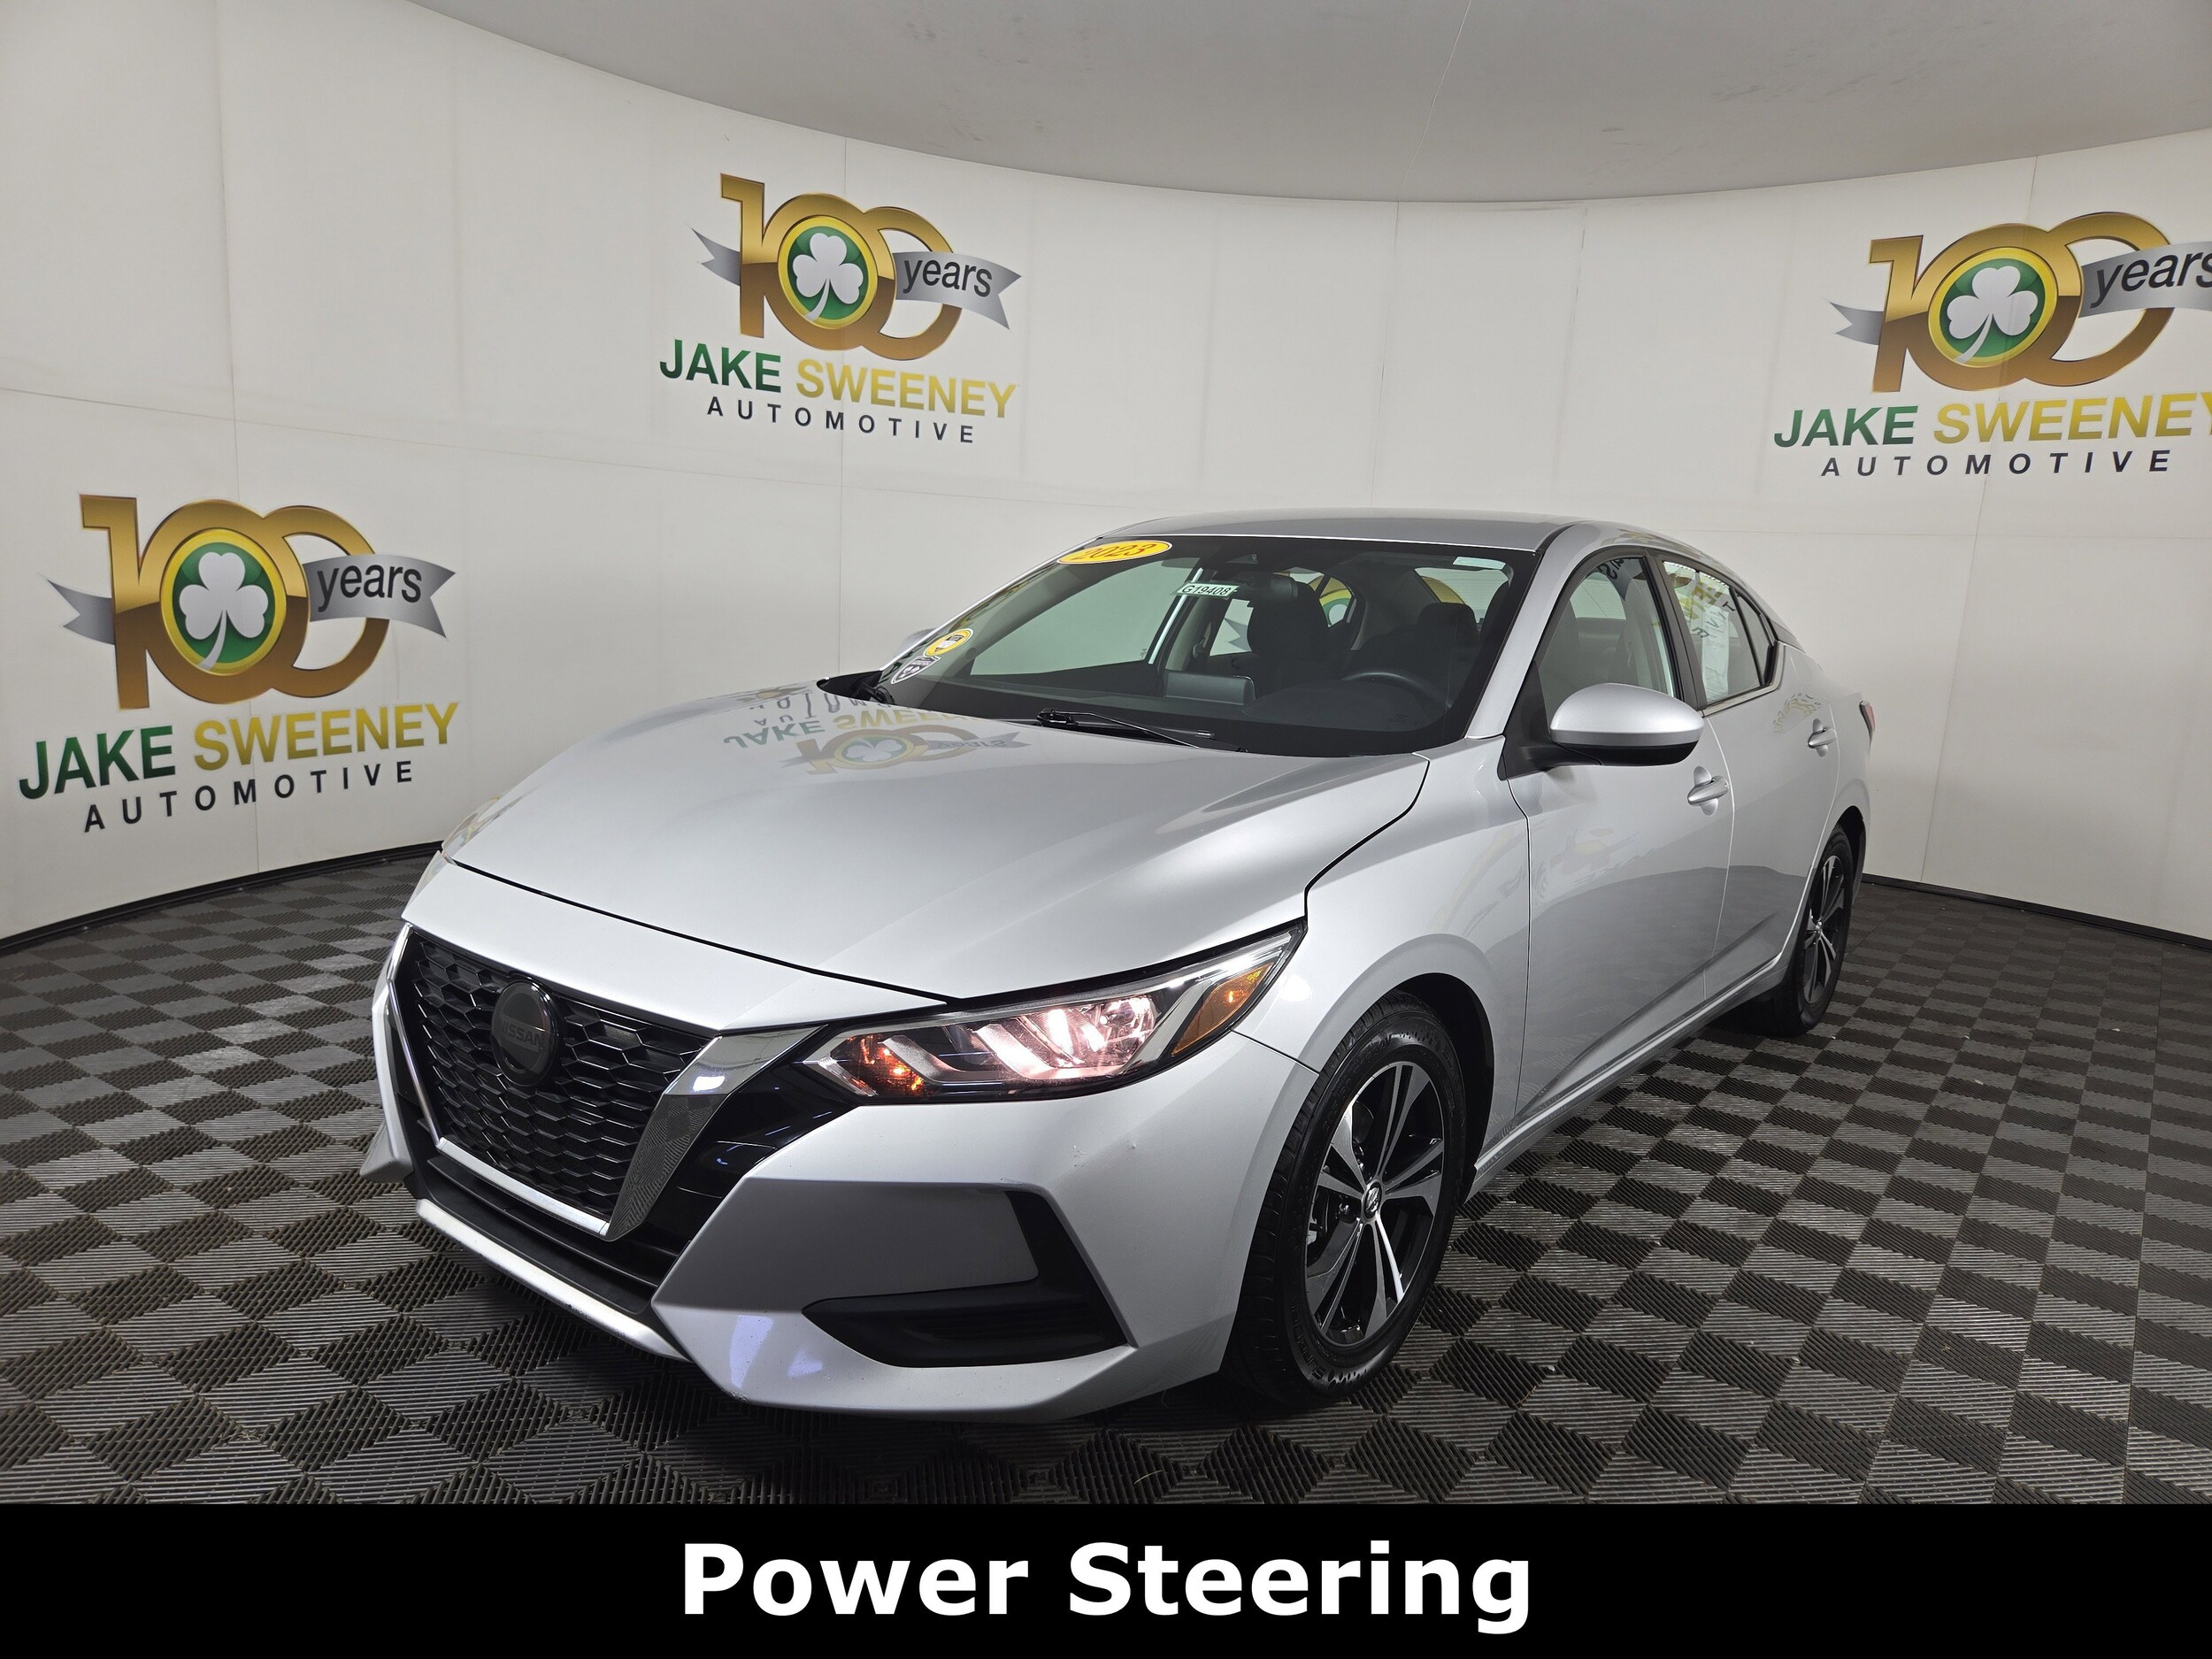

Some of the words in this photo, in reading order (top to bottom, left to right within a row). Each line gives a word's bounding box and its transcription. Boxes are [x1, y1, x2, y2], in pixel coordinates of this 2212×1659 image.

[720, 173, 963, 361] 100
[902, 257, 993, 298] years
[1869, 211, 2175, 394] 100
[2090, 250, 2212, 308] years
[659, 339, 781, 393] JAKE
[796, 358, 1018, 419] SWEENEY
[707, 396, 973, 443] AUTOMOTIVE
[1774, 405, 1919, 448] JAKE
[1821, 449, 2171, 477] AUTOMOTIVE
[1071, 543, 1157, 560] 2023
[80, 494, 390, 710] 100
[317, 563, 422, 612] years
[1182, 585, 1232, 595] G19408
[19, 726, 176, 800] JAKE
[194, 702, 459, 772] SWEENEY
[84, 760, 412, 833] AUTOMOTIVE
[499, 1018, 544, 1049] NISSAN
